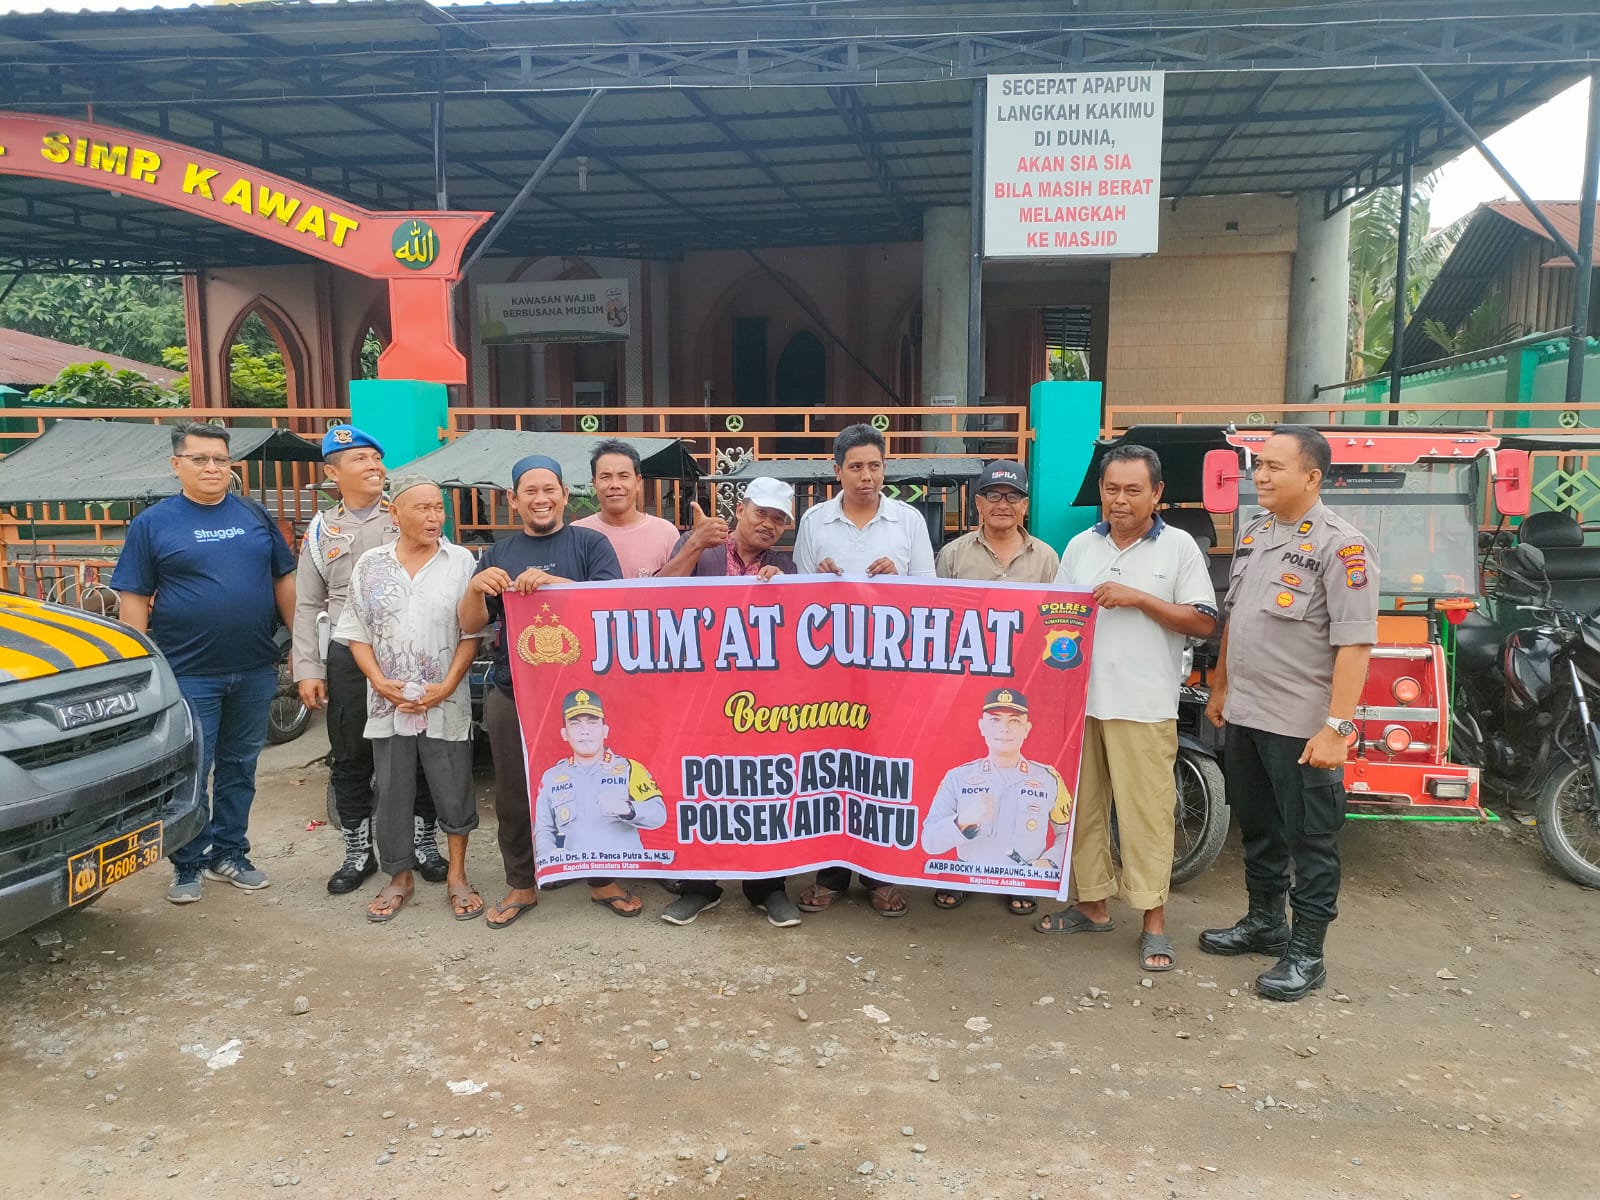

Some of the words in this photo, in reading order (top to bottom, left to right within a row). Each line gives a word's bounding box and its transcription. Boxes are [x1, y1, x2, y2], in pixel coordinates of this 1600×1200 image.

[1002, 78, 1077, 96] SECEPAT
[1082, 76, 1151, 94] APAPUN
[997, 104, 1080, 122] LANGKAH
[1085, 102, 1155, 120] KAKIMU
[1034, 130, 1051, 147] DI
[1057, 128, 1116, 148] DUNIA,
[1017, 156, 1065, 172] AKAN
[1070, 155, 1098, 172] SIA
[1103, 153, 1132, 171] SIA
[994, 182, 1033, 199] BILA
[1038, 180, 1092, 198] MASIH
[1098, 178, 1154, 197] BERAT
[182, 162, 360, 248] KAWAT
[1019, 204, 1126, 223] MELANGKAH
[1026, 232, 1049, 248] KE
[1054, 230, 1118, 248] MASJID
[511, 294, 562, 306] KAWASAN
[564, 293, 596, 304] WAJIB
[503, 307, 563, 318] BERBUSANA
[565, 305, 604, 317] MUSLIM
[193, 526, 246, 540] Struggle
[1280, 551, 1321, 573] POLRI
[1041, 602, 1087, 613] POLRES
[591, 603, 784, 675] JUM'AT
[795, 602, 1023, 678] CURHAT
[57, 691, 138, 728] ISUZU
[722, 689, 871, 734] Bersama
[601, 777, 627, 785] POLRI
[683, 755, 795, 799] POLRES
[799, 751, 911, 800] ASAHAN
[551, 782, 574, 794] PANCA
[1020, 788, 1049, 800] POLRI
[680, 802, 789, 842] POLSEK
[793, 796, 841, 836] AIR
[849, 799, 916, 847] BATU
[105, 844, 158, 885] 2608-36
[550, 854, 564, 863] Pol.
[565, 853, 581, 861] Drs.
[591, 852, 598, 860] Z.
[599, 851, 621, 861] Panca
[623, 851, 642, 861] Putra
[563, 864, 590, 872] Kapolda
[590, 863, 620, 871] Sumatera
[928, 861, 949, 870] AKBP
[949, 863, 974, 873] ROCKY
[974, 864, 982, 874] H.
[983, 866, 1026, 878] MARPAUNG,
[969, 876, 998, 887] Kapolres
[1000, 879, 1026, 887] Asahan
